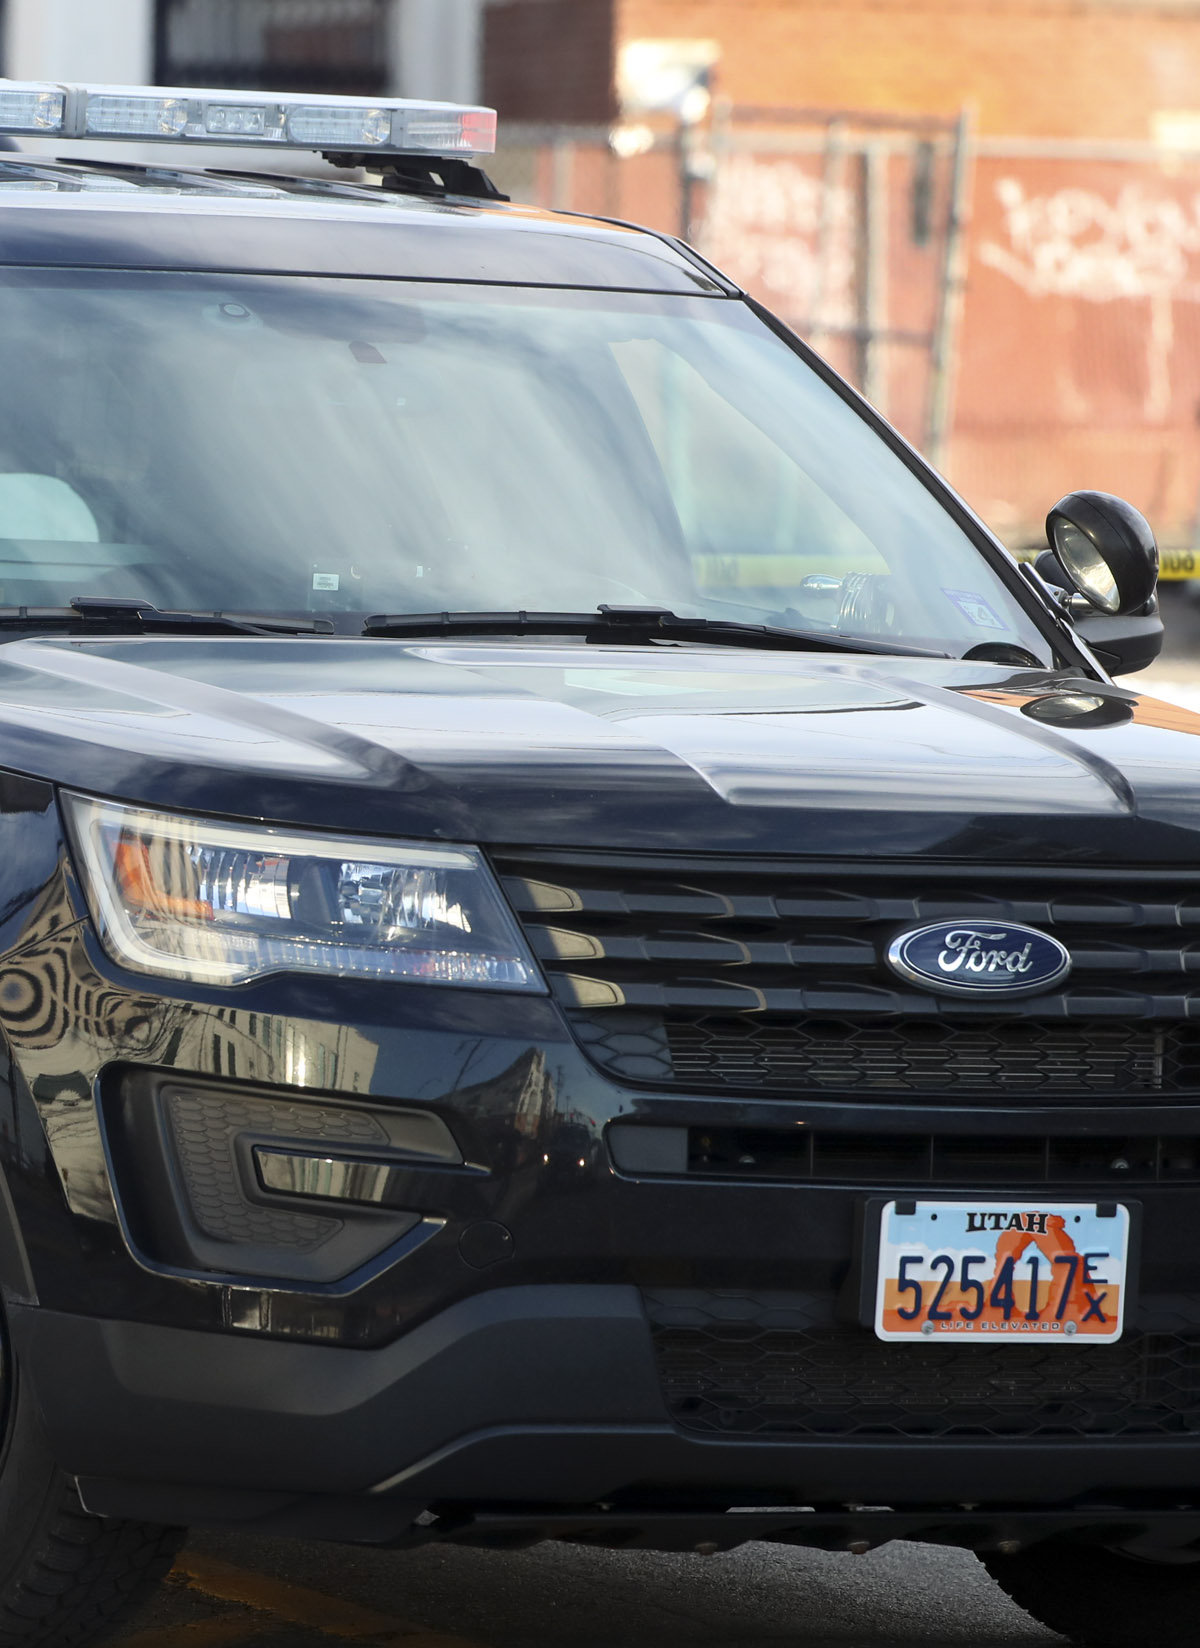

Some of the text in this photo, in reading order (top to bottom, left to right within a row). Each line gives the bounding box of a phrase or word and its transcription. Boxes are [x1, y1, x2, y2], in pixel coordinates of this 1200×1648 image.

[937, 929, 1033, 973] Ford
[965, 1212, 1049, 1235] UTAH
[897, 1254, 1079, 1321] 525417
[940, 1321, 1061, 1331] LIFE ELEVATED
